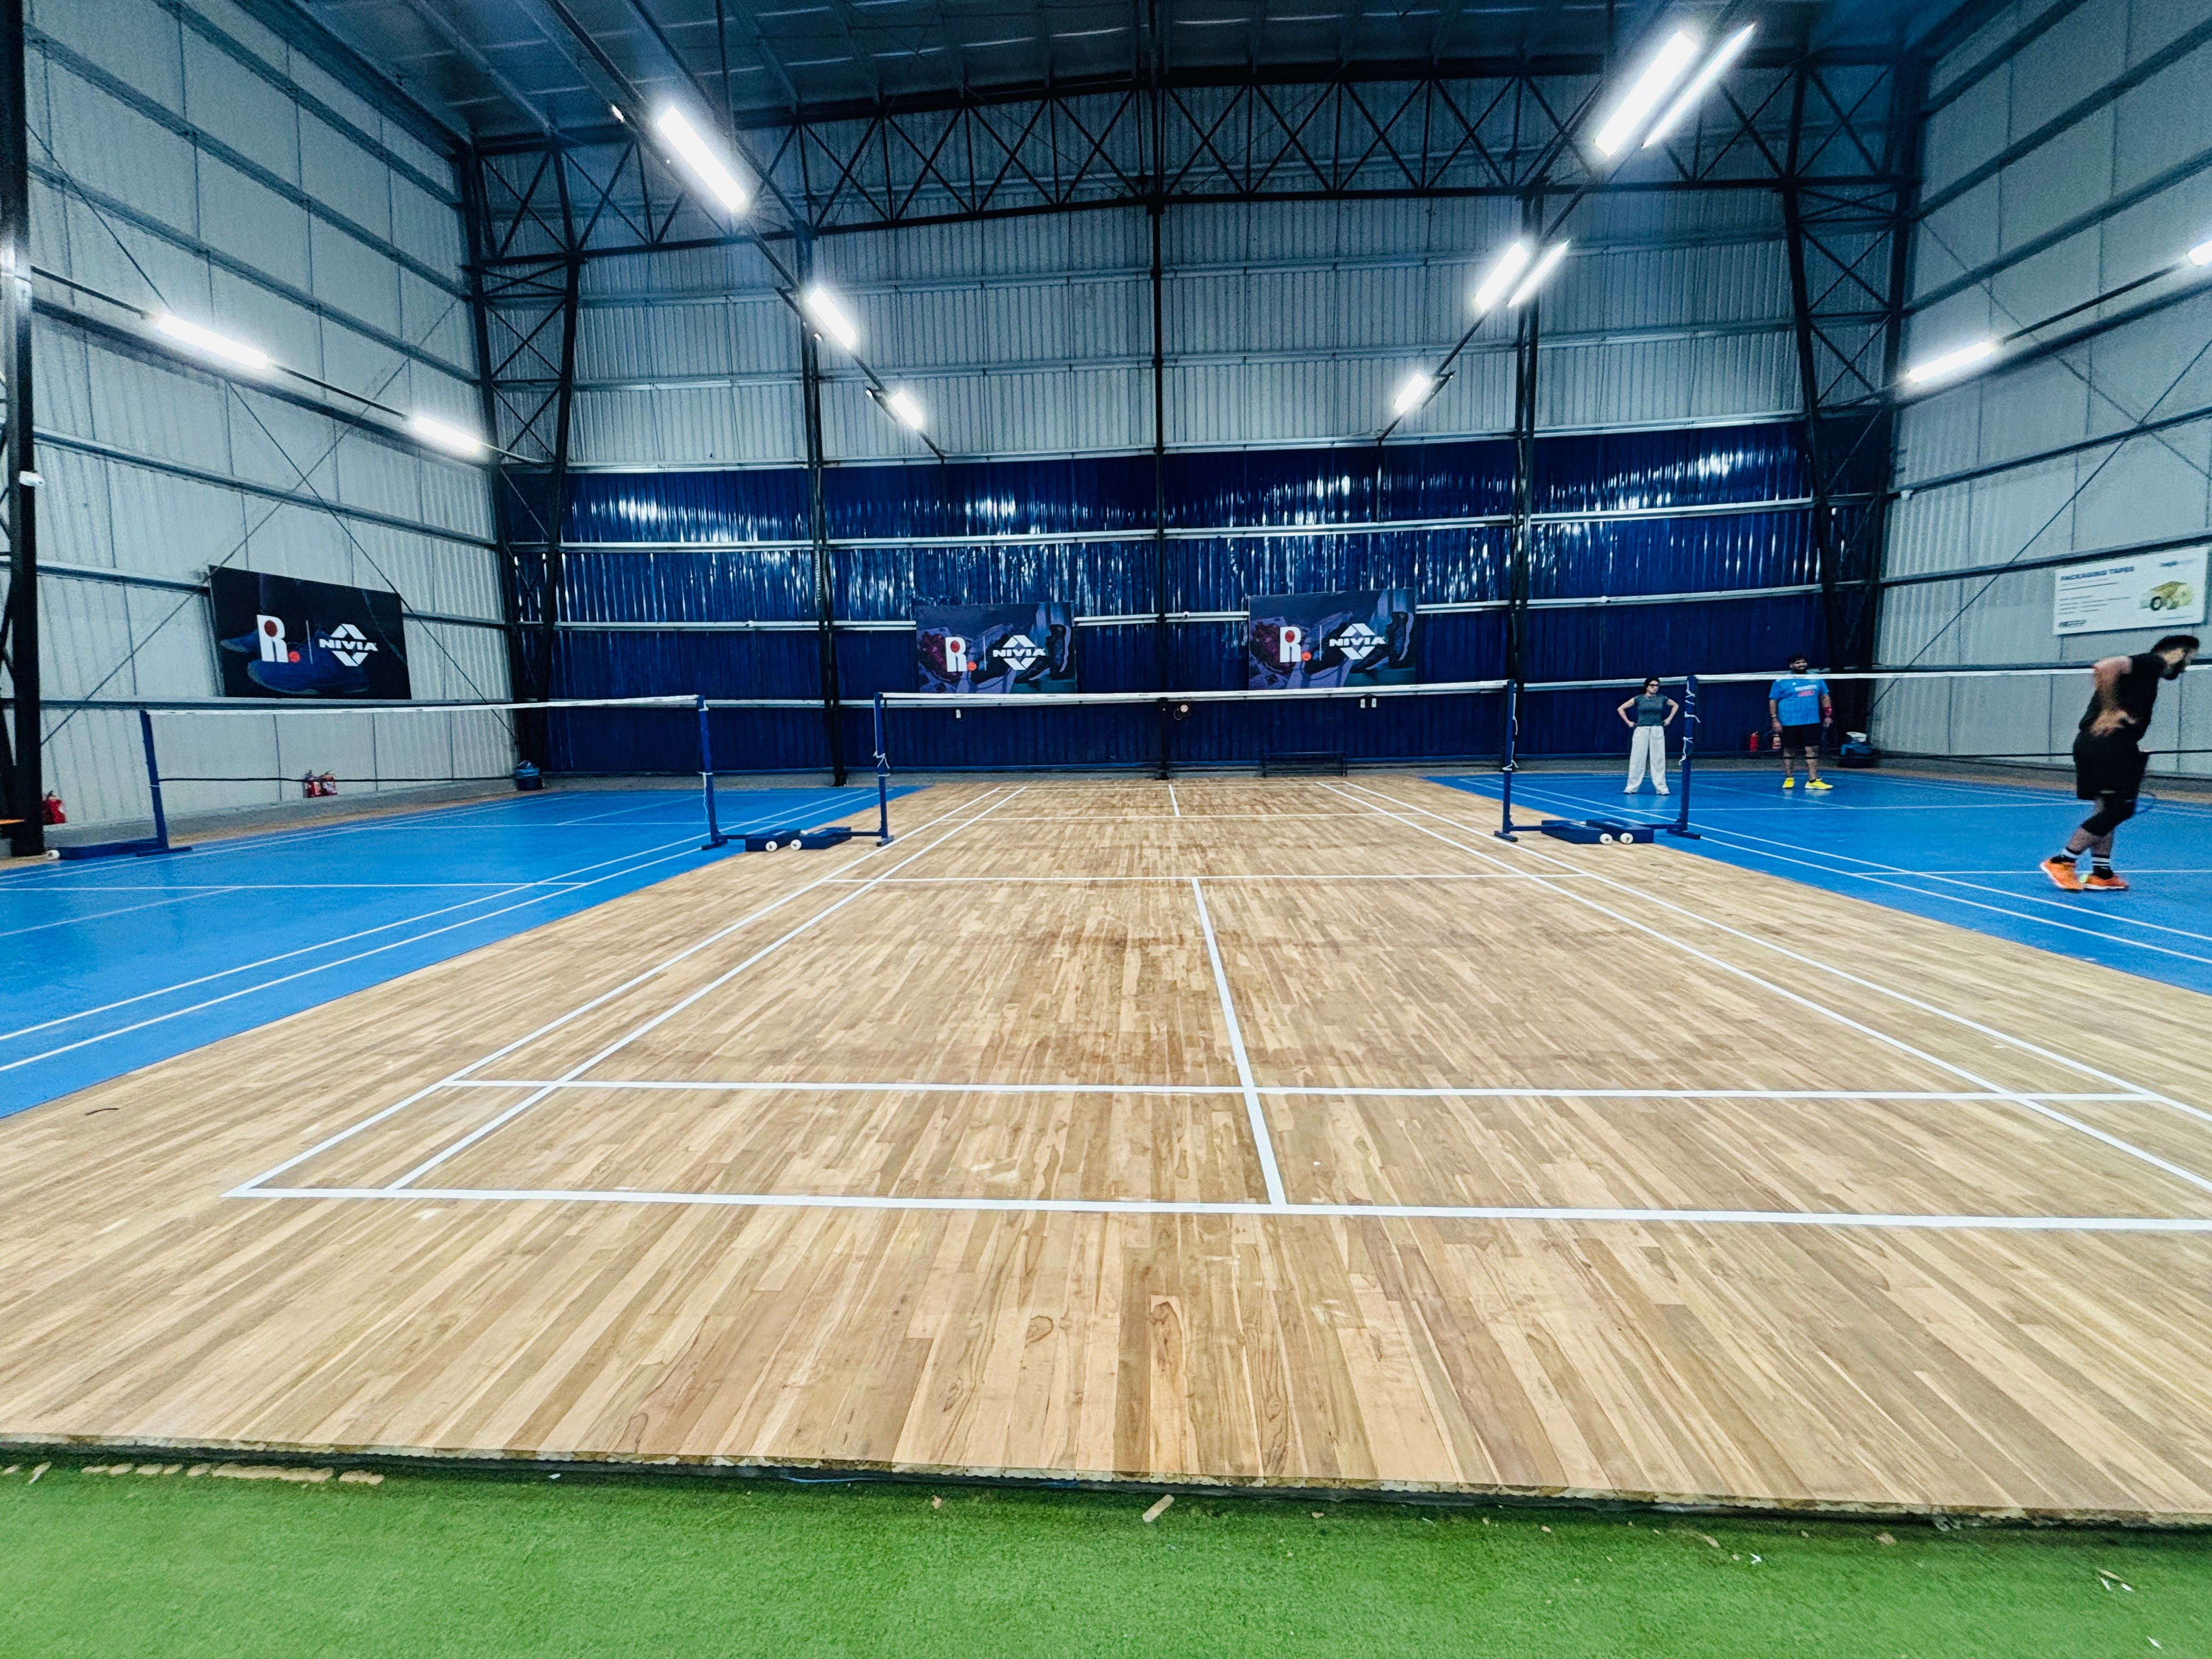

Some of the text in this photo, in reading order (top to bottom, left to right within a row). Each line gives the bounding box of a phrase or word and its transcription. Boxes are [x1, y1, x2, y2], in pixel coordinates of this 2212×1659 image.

[319, 638, 379, 652] NIVIA
[1329, 636, 1386, 647] NIVIA
[992, 648, 1046, 657] NIVIA
